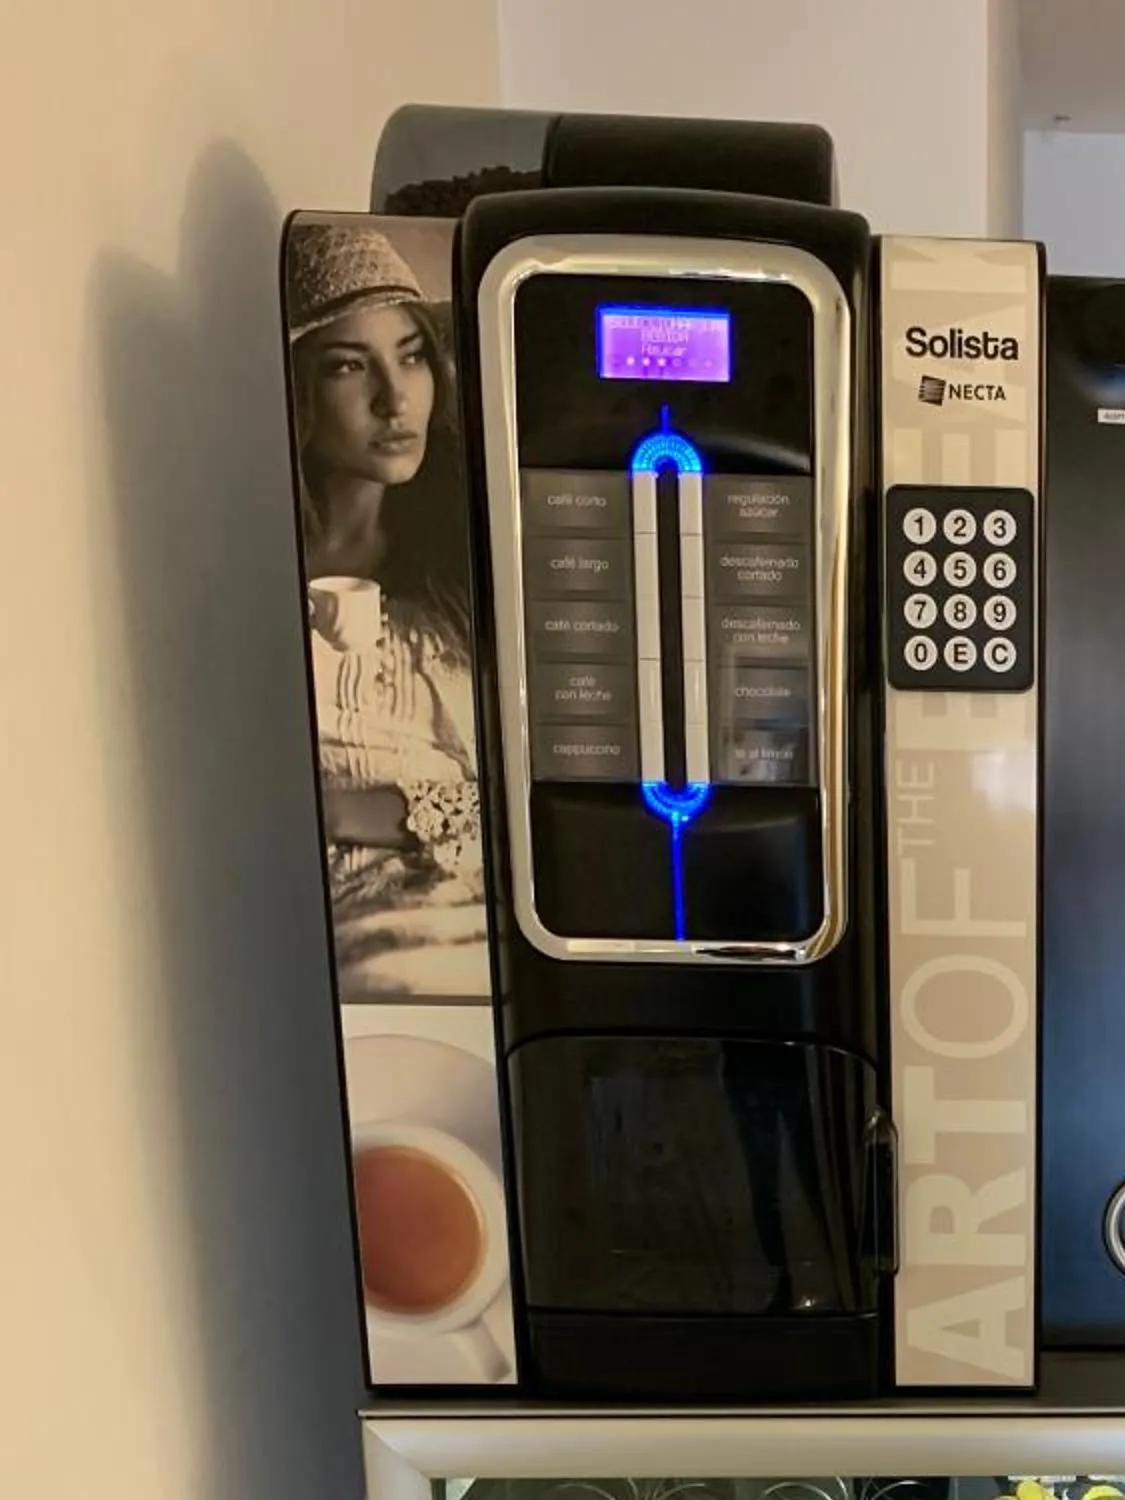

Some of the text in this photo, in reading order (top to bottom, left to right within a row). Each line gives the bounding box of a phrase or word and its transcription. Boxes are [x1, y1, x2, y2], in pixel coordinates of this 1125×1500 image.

[905, 326, 1019, 360] Solista
[949, 383, 1006, 401] NECTA
[913, 515, 1006, 538] 1 2 3
[913, 559, 1006, 581] 4 5 6
[913, 601, 1006, 623] 7 8 9
[914, 643, 1008, 665] 0 E C
[896, 759, 935, 857] THE
